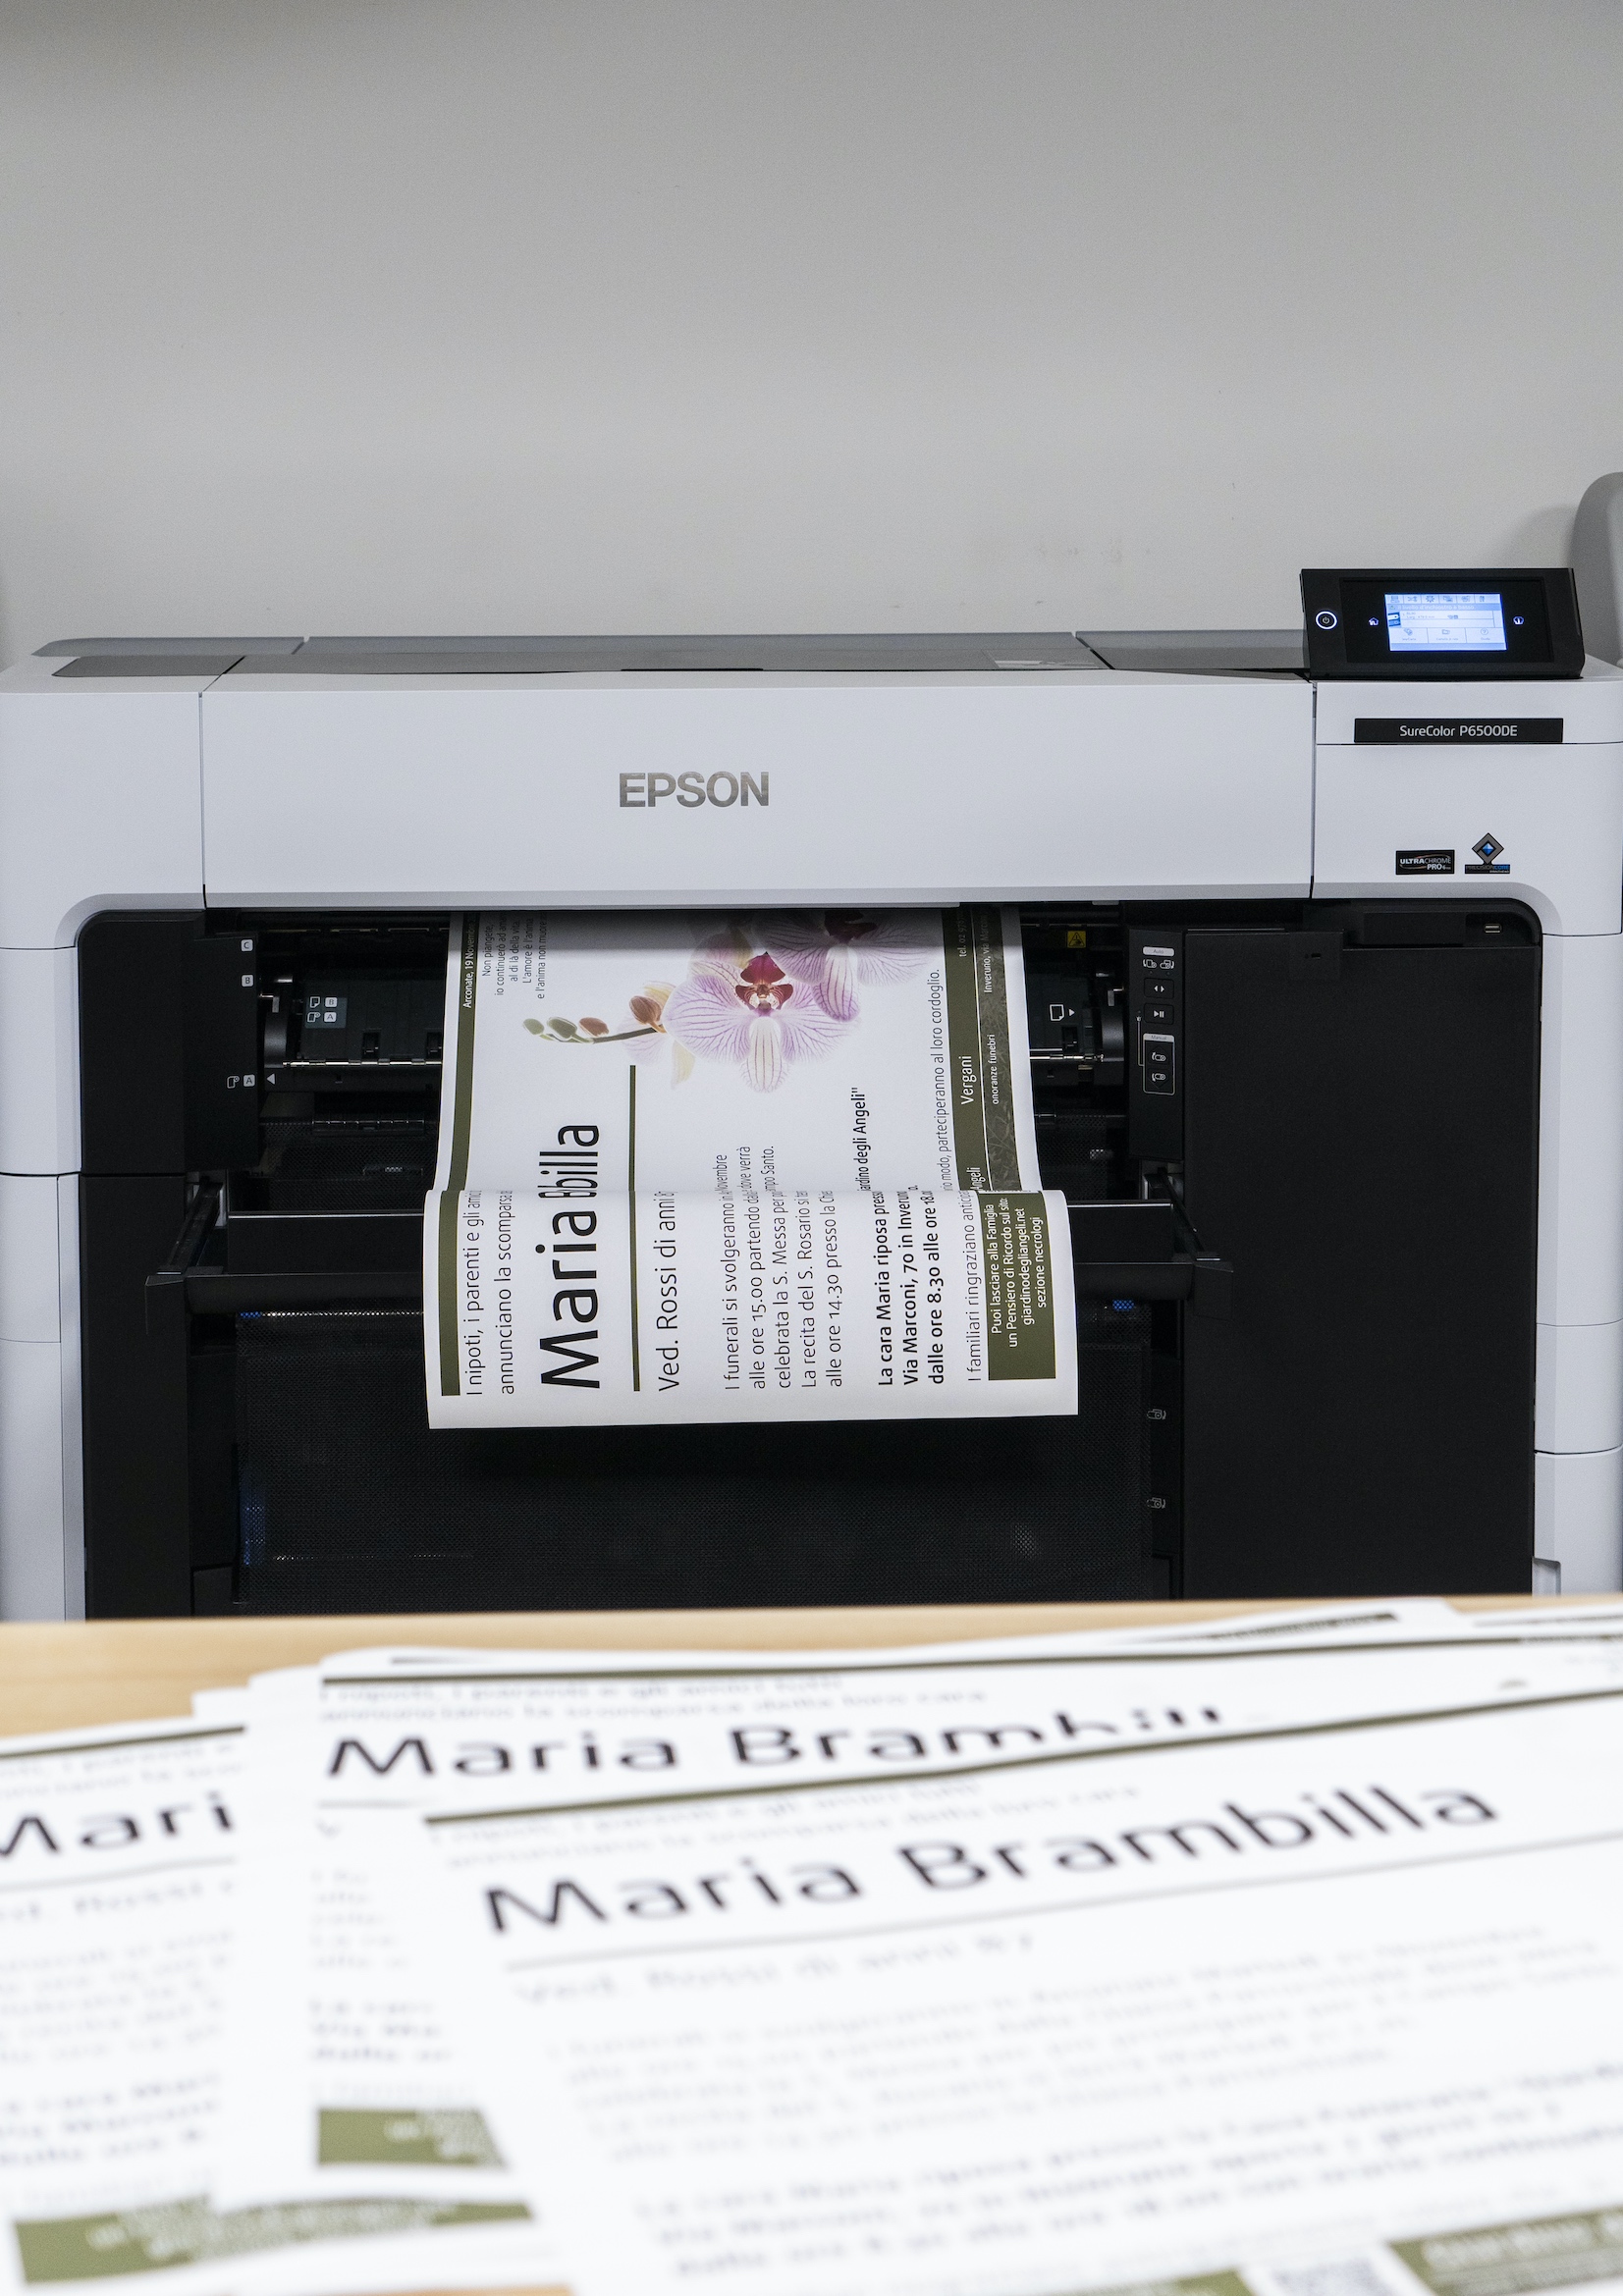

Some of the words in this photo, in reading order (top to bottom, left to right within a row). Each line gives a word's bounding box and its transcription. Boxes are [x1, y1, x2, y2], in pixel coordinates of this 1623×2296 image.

[1399, 724, 1455, 737] SureColor
[1459, 724, 1518, 737] P6500DE
[619, 772, 769, 807] EPSON
[510, 936, 519, 953] della
[957, 945, 967, 957] tel.
[464, 960, 474, 969] 19
[482, 960, 491, 977] Non
[496, 944, 506, 986] continuerò
[522, 952, 532, 984] L'amore
[535, 963, 545, 990] l'anima
[984, 956, 993, 992] Inveruno,
[462, 971, 474, 1008] Arconate,
[927, 969, 944, 1024] cordoglio.
[930, 1028, 944, 1049] loro
[986, 1034, 998, 1064] funebri
[931, 1053, 944, 1063] al
[958, 1055, 977, 1105] Vergani
[988, 1066, 1000, 1104] onoranze
[850, 1087, 868, 1134] Angeli"
[932, 1067, 951, 1152] parteciperanno
[736, 1147, 751, 1171] verrà
[760, 1146, 775, 1175] Santo.
[852, 1138, 869, 1164] degli
[936, 1155, 951, 1181] modo,
[966, 1167, 986, 1191] Angeli
[462, 1212, 484, 1227] gli
[654, 1199, 676, 1231] anni
[772, 1199, 788, 1213] per
[820, 1206, 836, 1215] la
[924, 1207, 937, 1228] ore
[999, 1198, 1010, 1210] sito:
[1000, 1212, 1011, 1224] sul
[466, 1232, 480, 1242] e
[744, 1206, 766, 1270] partendo
[795, 1208, 812, 1259] Rosario
[984, 1204, 1000, 1240] Famiglia
[653, 1240, 676, 1257] di
[721, 1202, 739, 1292] svolgeranno
[772, 1217, 787, 1264] Messa
[825, 1219, 841, 1268] presso
[873, 1218, 892, 1265] riposa
[898, 1235, 913, 1248] in
[923, 1233, 940, 1261] alle
[987, 1243, 998, 1260] alla
[1001, 1227, 1014, 1264] Ricordo
[1031, 1217, 1045, 1262] necrologi
[463, 1248, 484, 1311] parenti
[494, 1267, 511, 1281] la
[773, 1271, 787, 1285] S.
[798, 1266, 813, 1279] S.
[902, 1254, 918, 1273] 70
[962, 1225, 982, 1306] ringraziano
[1004, 1267, 1014, 1277] di
[1014, 1207, 1035, 1325] giardinodegliangeli.net
[535, 1210, 600, 1389] Maria
[655, 1267, 678, 1329] Rossi
[751, 1277, 767, 1321] 15.00
[772, 1291, 788, 1305] la
[797, 1286, 814, 1311] del
[827, 1274, 842, 1319] 14.30
[874, 1271, 892, 1320] Maria
[927, 1266, 944, 1304] 8.30
[988, 1263, 1001, 1306] lasciare
[1034, 1265, 1047, 1308] sezione
[723, 1299, 737, 1310] si
[900, 1278, 918, 1353] Marconi,
[1002, 1281, 1017, 1329] Pensiero
[931, 1309, 943, 1338] ore
[991, 1308, 1001, 1334] Puoi
[495, 1289, 514, 1394] annunciano
[722, 1317, 739, 1380] funerali
[751, 1327, 764, 1355] ore
[774, 1311, 790, 1388] celebrata
[800, 1317, 815, 1363] recita
[827, 1325, 841, 1353] ore
[879, 1326, 893, 1362] cara
[965, 1311, 981, 1372] familiari
[1008, 1333, 1018, 1348] un
[464, 1330, 485, 1385] nipoti,
[655, 1340, 679, 1392] Ved.
[826, 1359, 841, 1387] alle
[902, 1360, 918, 1385] Via
[928, 1344, 944, 1384] dalle
[749, 1361, 766, 1389] alle
[801, 1370, 816, 1388] La
[878, 1368, 893, 1386] La
[326, 1731, 678, 1778] Maria
[0, 1790, 235, 1857] Mari
[484, 1856, 865, 1935] Maria
[896, 1785, 1500, 1891] Brambilla
